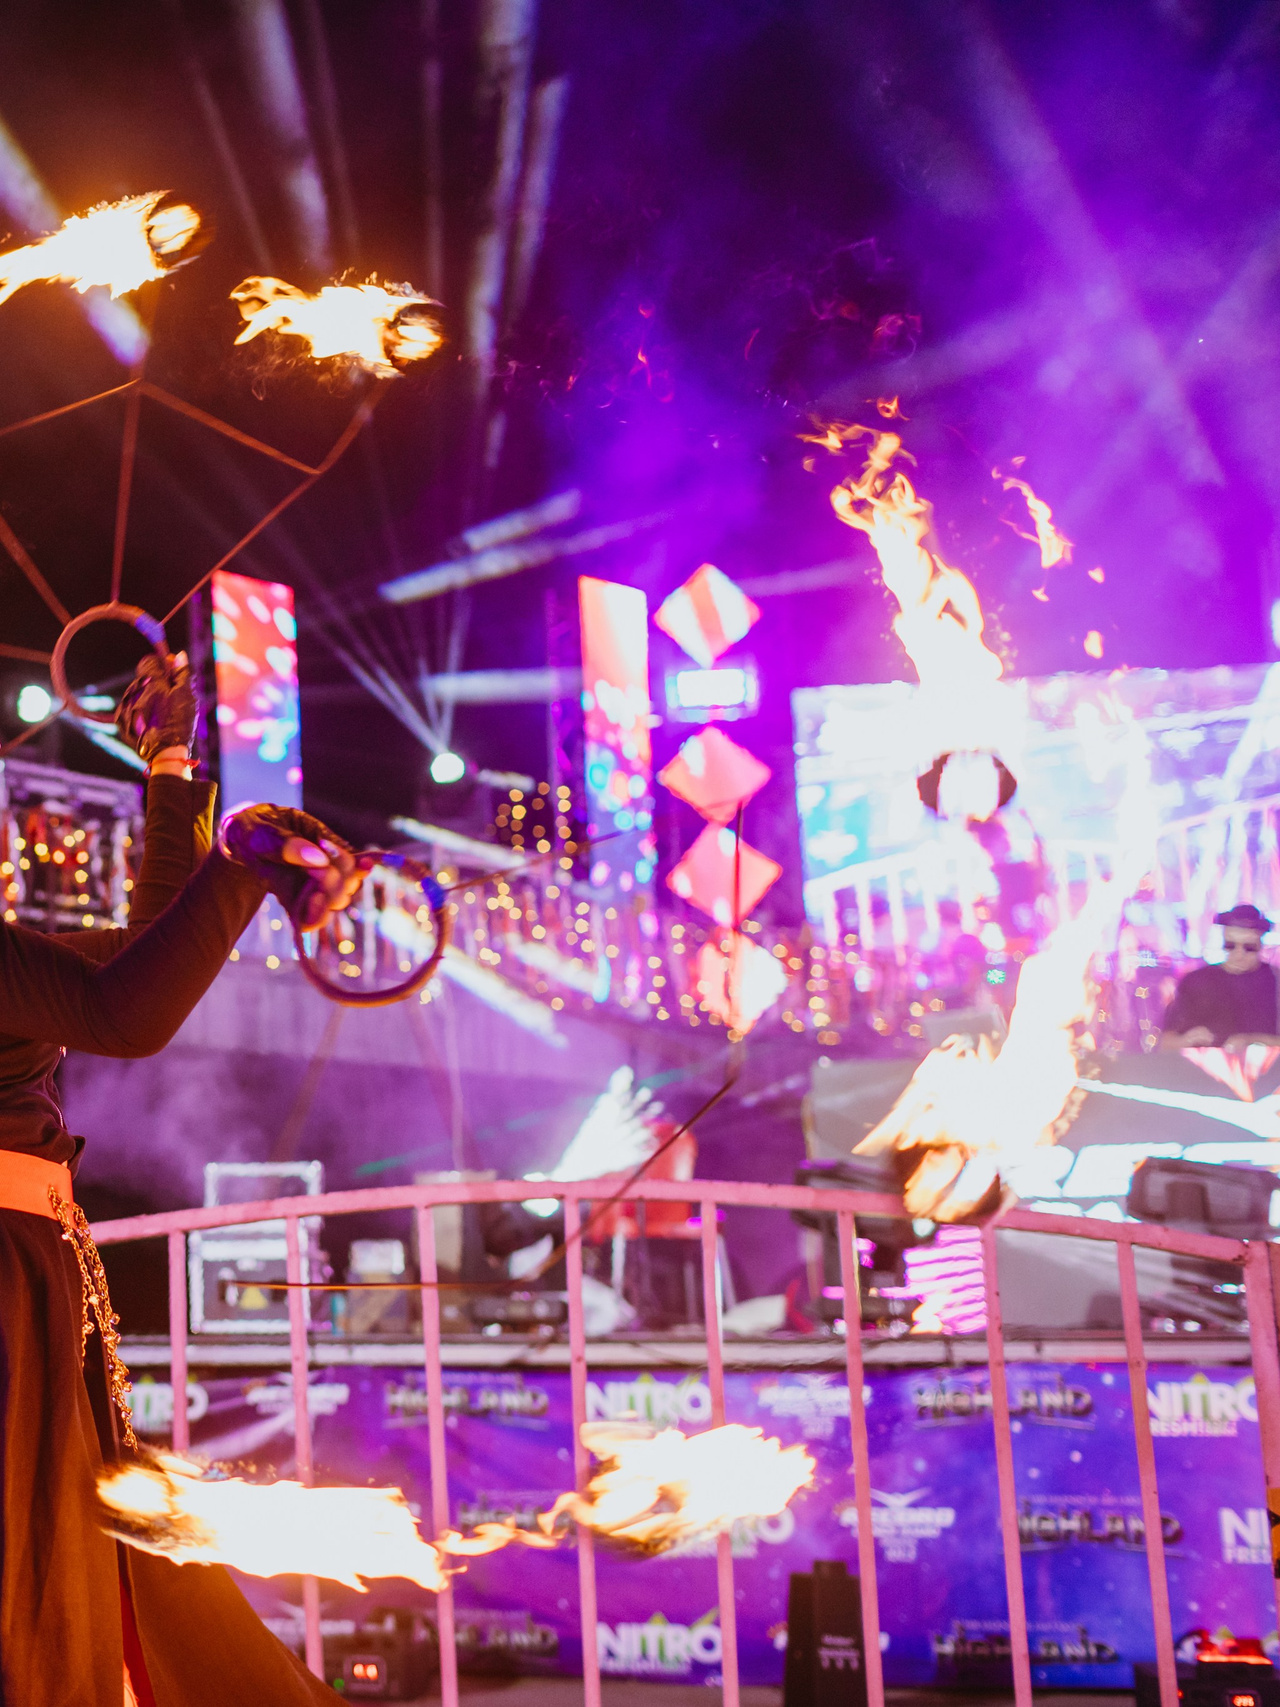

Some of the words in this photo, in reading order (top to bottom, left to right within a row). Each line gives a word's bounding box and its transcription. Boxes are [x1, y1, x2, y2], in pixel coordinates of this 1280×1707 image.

[587, 1382, 713, 1422] NITRO
[1000, 1503, 1184, 1541] IGHLAND
[596, 1622, 722, 1663] NITRO
